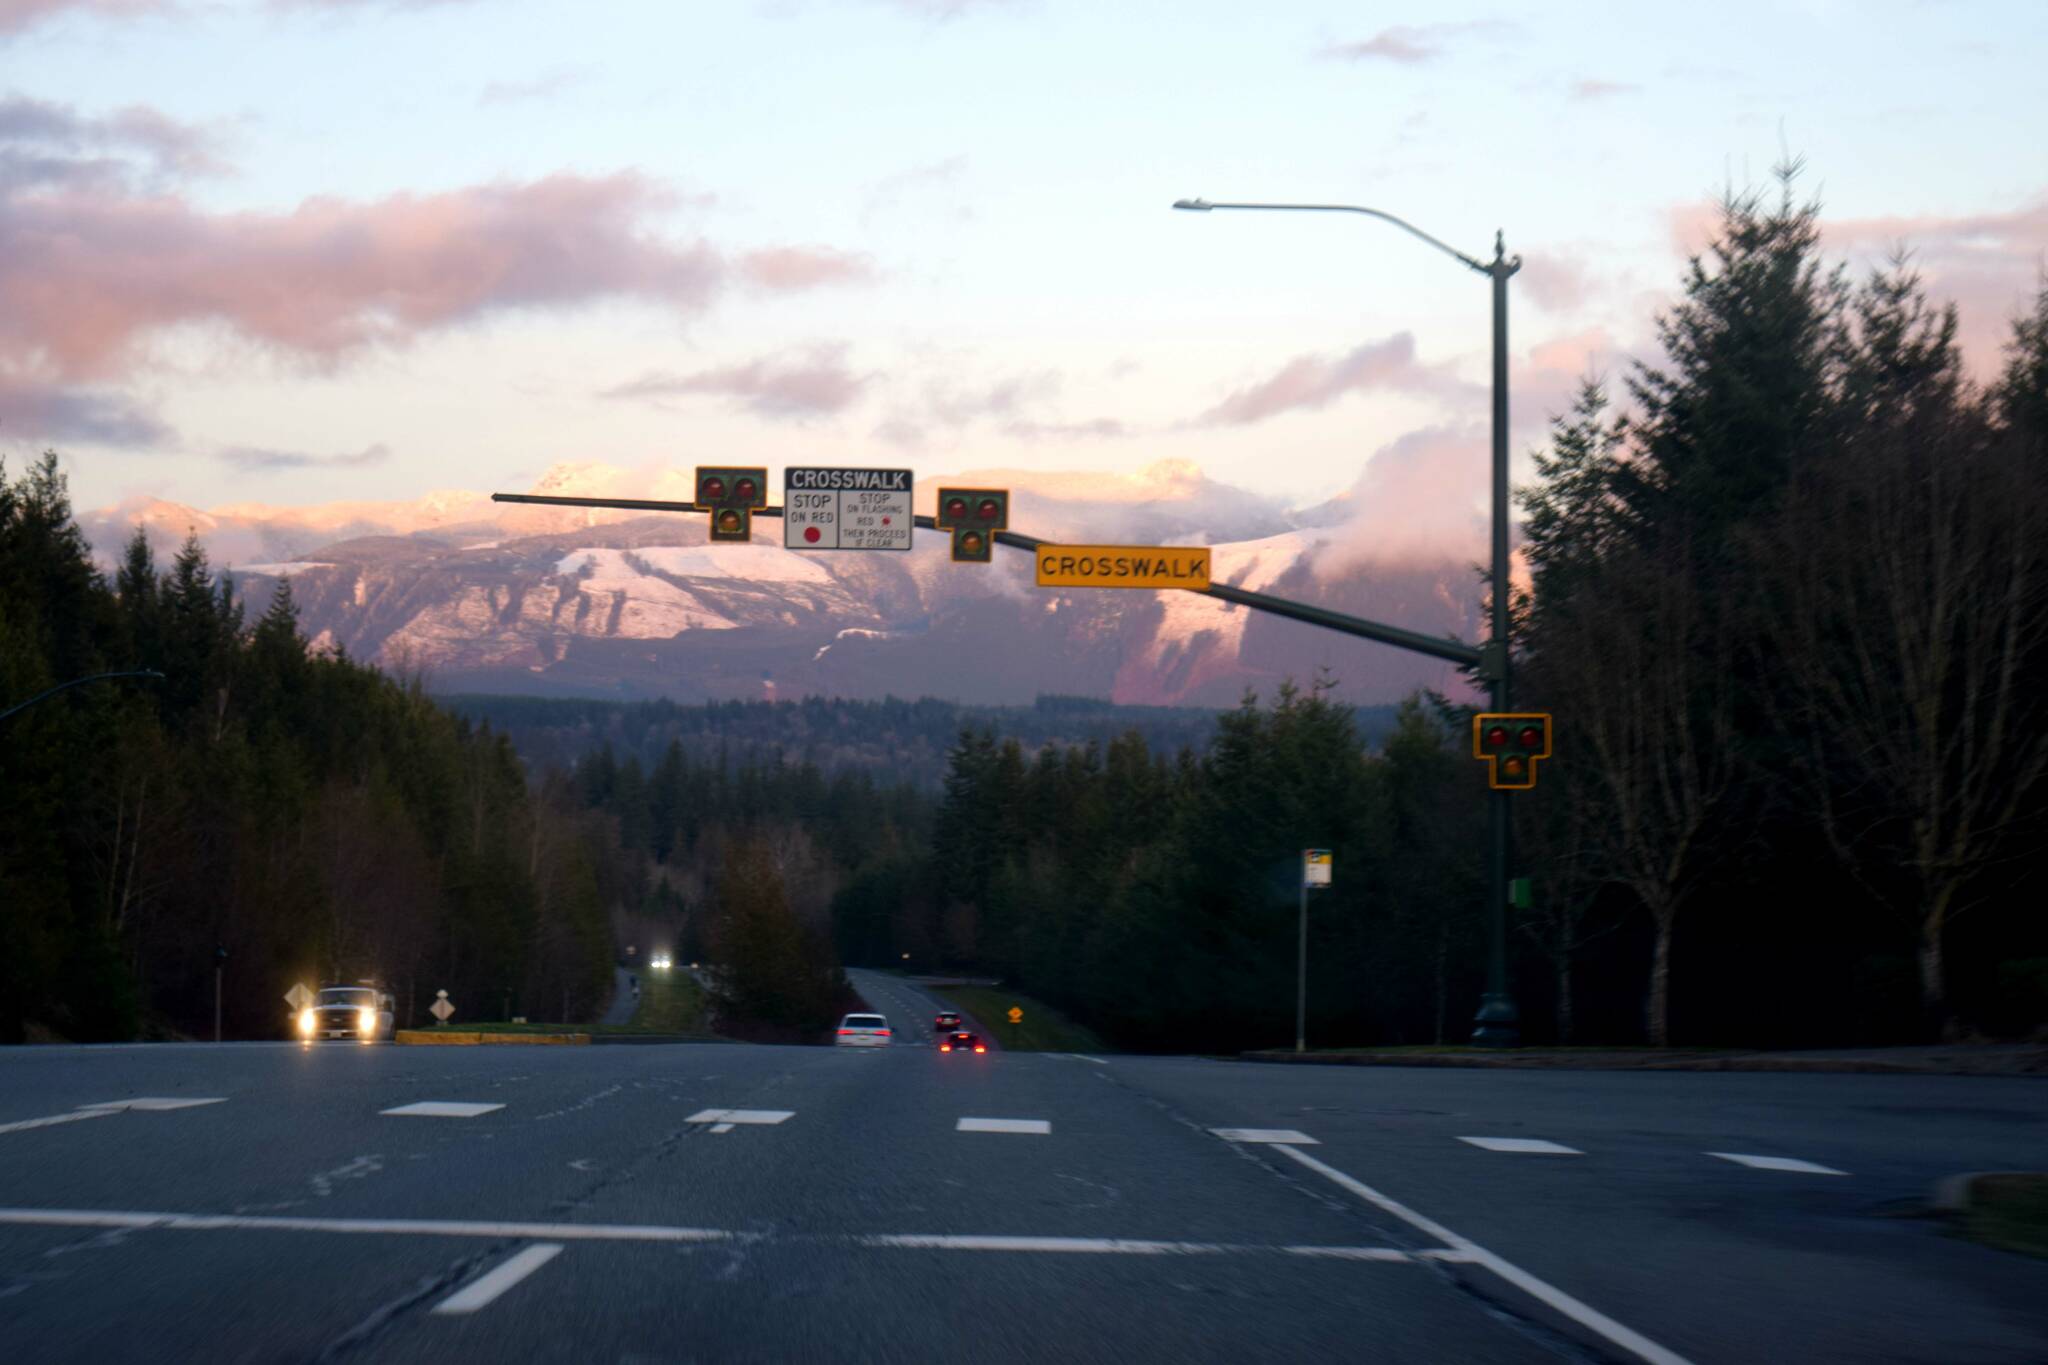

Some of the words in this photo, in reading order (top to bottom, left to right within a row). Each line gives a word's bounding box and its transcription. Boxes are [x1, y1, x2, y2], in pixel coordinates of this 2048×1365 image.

[792, 470, 905, 489] CROSSWALK
[794, 495, 831, 508] STOP
[860, 493, 891, 504] STOP
[848, 505, 858, 513] ON
[862, 505, 903, 514] FLASHING
[791, 512, 805, 522] ON
[812, 513, 833, 523] RED
[857, 517, 873, 525] RED
[844, 529, 864, 537] THEN
[867, 539, 893, 547] CLEAR
[1041, 556, 1205, 577] CROSSWALK
